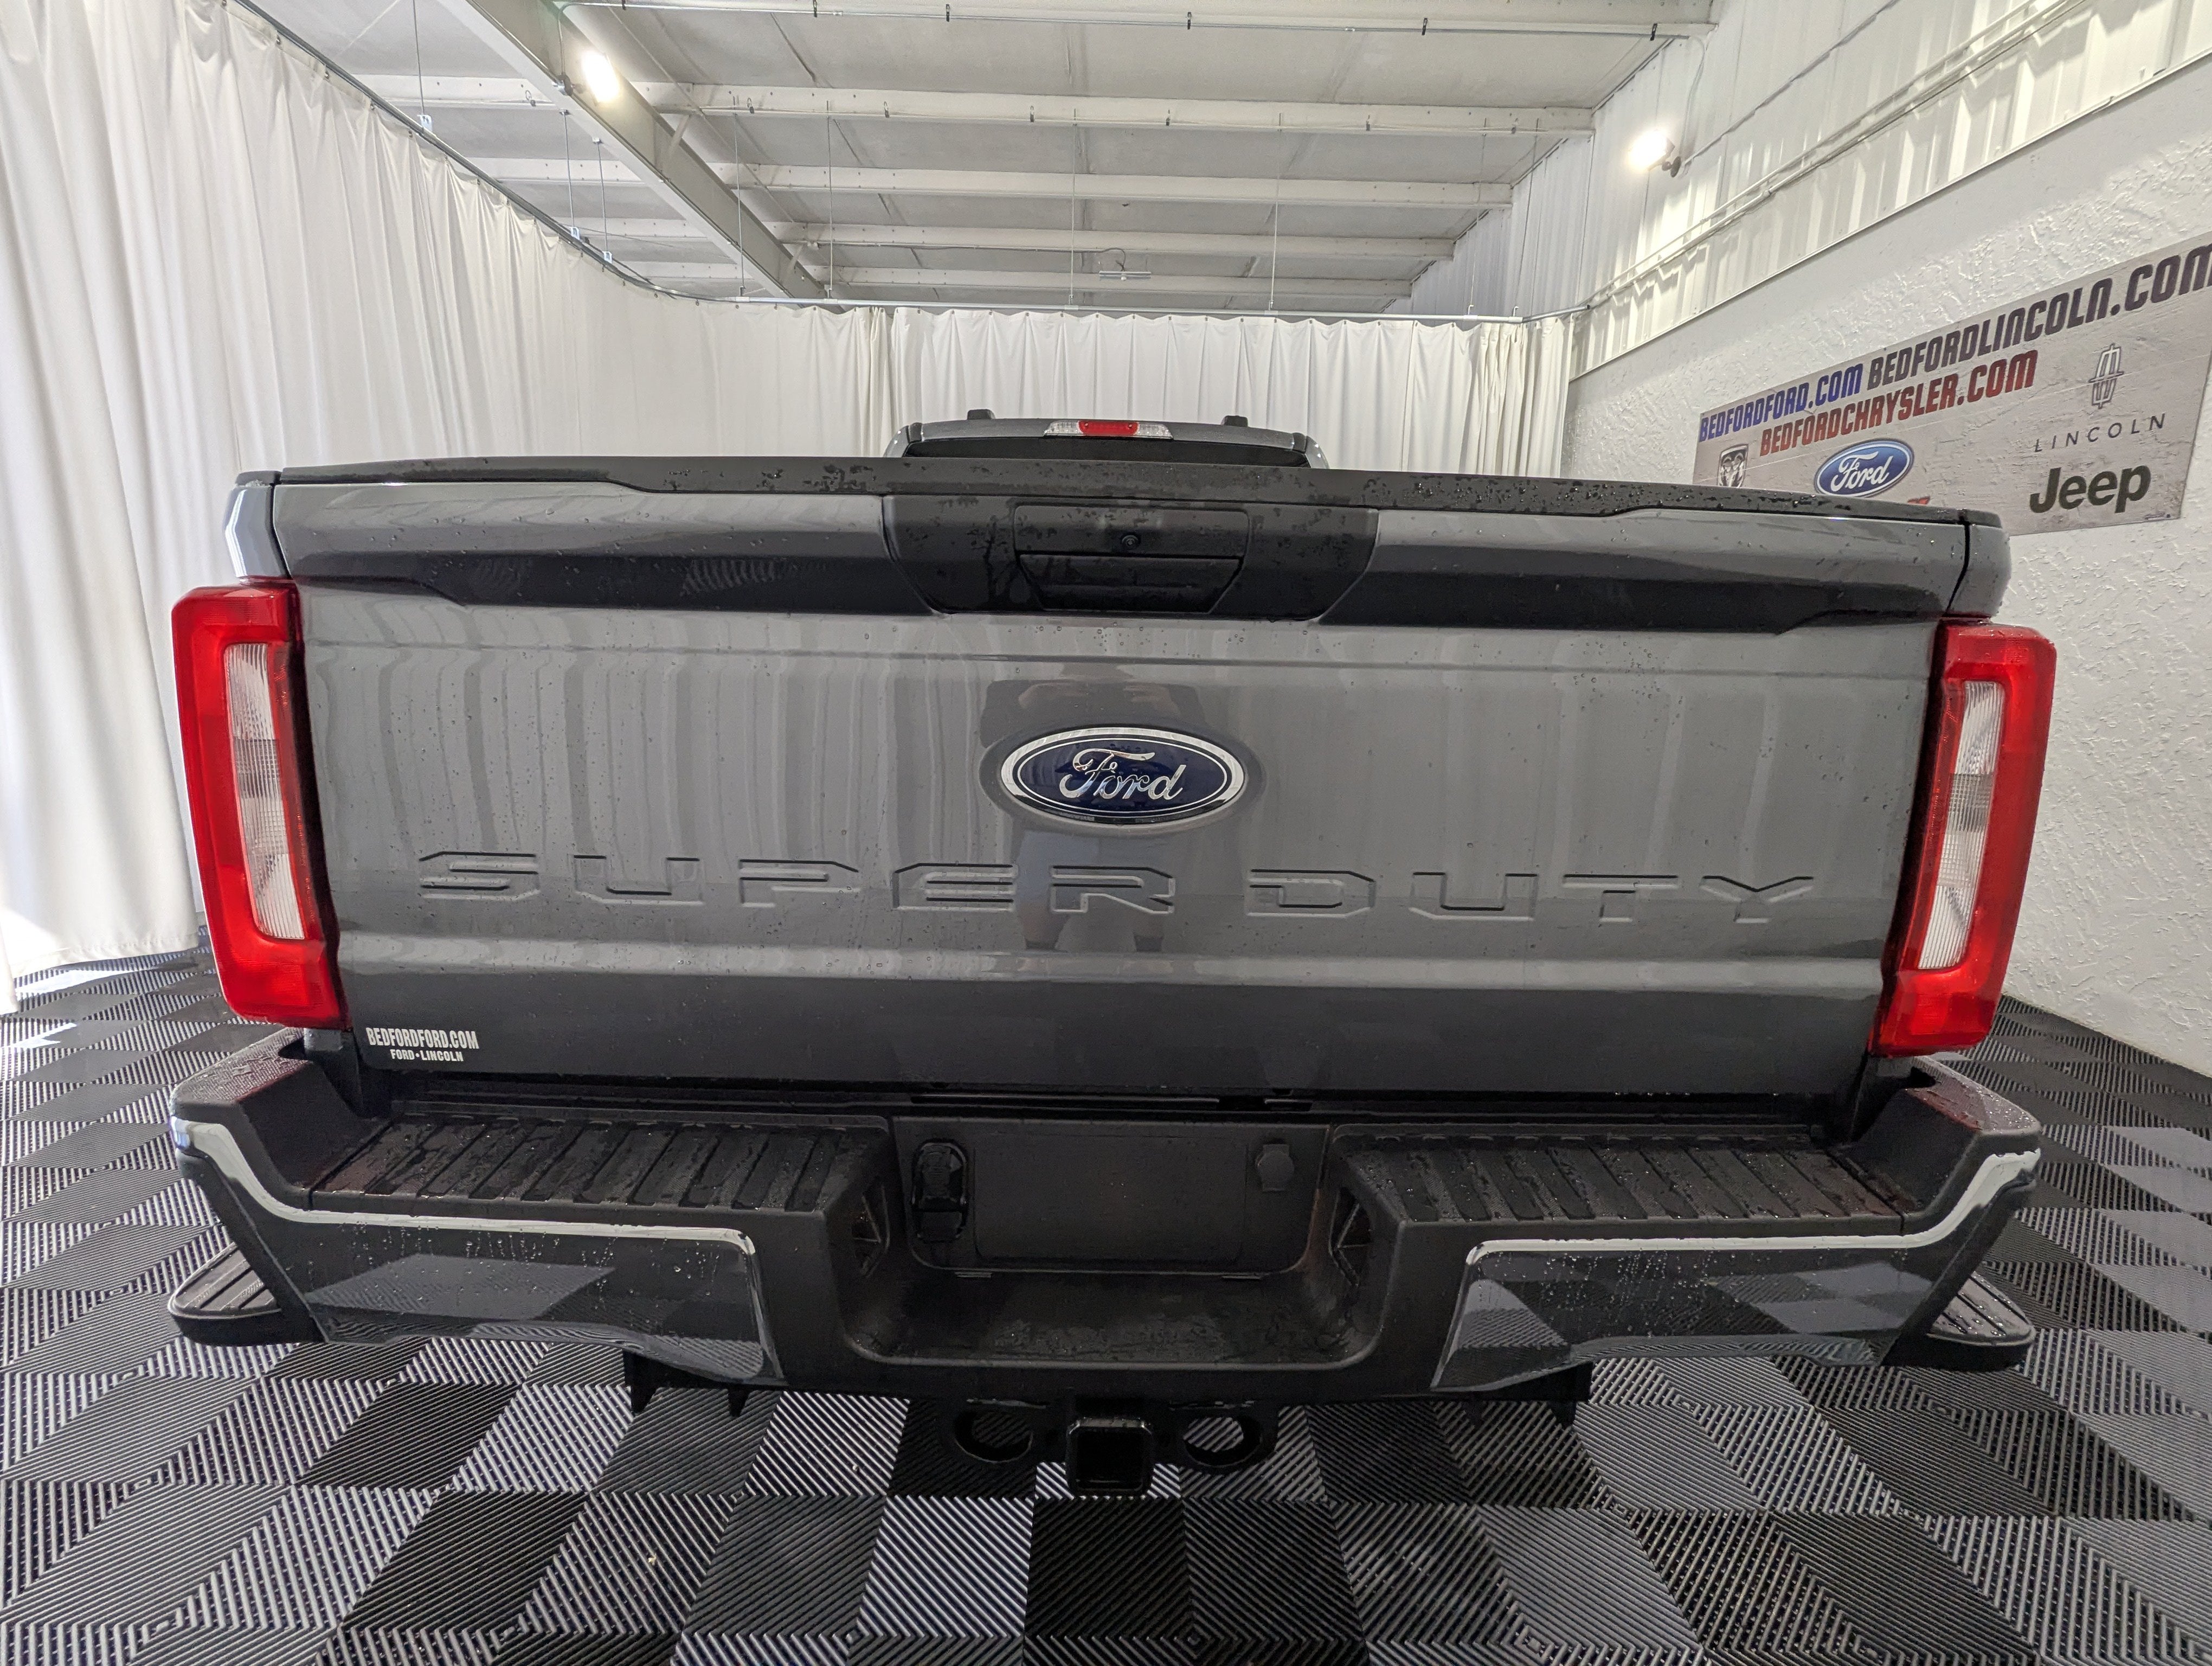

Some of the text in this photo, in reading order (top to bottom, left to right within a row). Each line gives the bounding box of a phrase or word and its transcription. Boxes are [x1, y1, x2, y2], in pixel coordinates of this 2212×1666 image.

[1699, 243, 2212, 443] BEDFORDFORD.COM BEDFORDLINCOLN.COM
[1760, 349, 2038, 457] BEDFORDCHRYSLER.COM
[2034, 413, 2165, 452] LINCOLN
[1830, 451, 1894, 492] Ford
[2029, 465, 2151, 514] Jeep
[1059, 748, 1187, 800] Ford
[419, 851, 1815, 925] SUPER DUTY
[366, 1027, 479, 1049] BEDFORDFORD.COM
